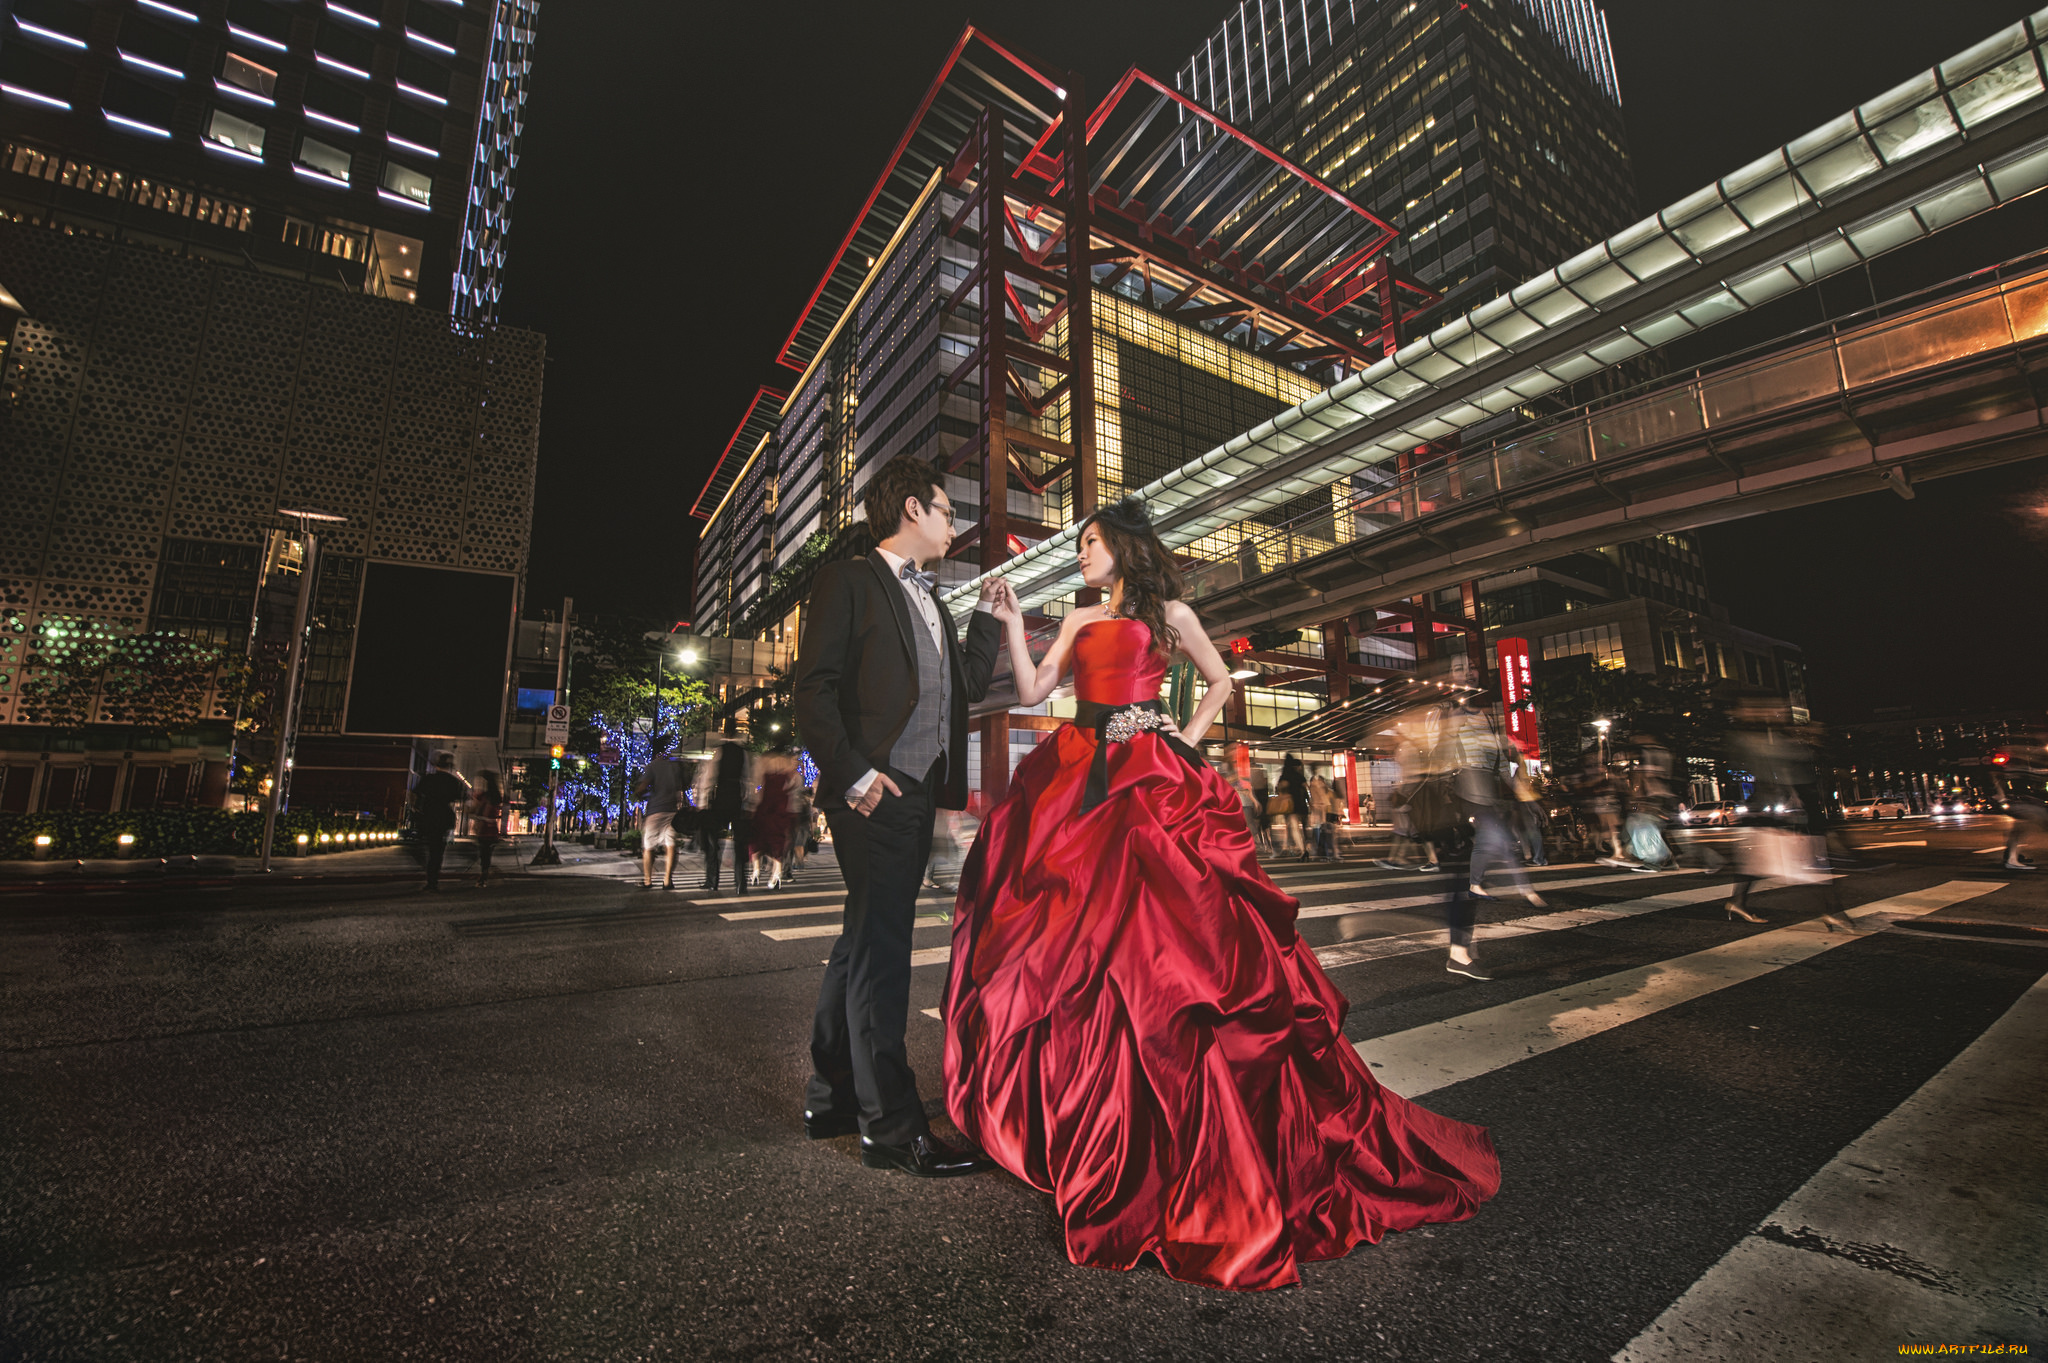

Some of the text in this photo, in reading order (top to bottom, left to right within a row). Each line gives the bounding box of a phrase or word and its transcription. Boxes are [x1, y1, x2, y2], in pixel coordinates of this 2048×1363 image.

[1505, 655, 1519, 732] SHIN KONG MITKOSHI
